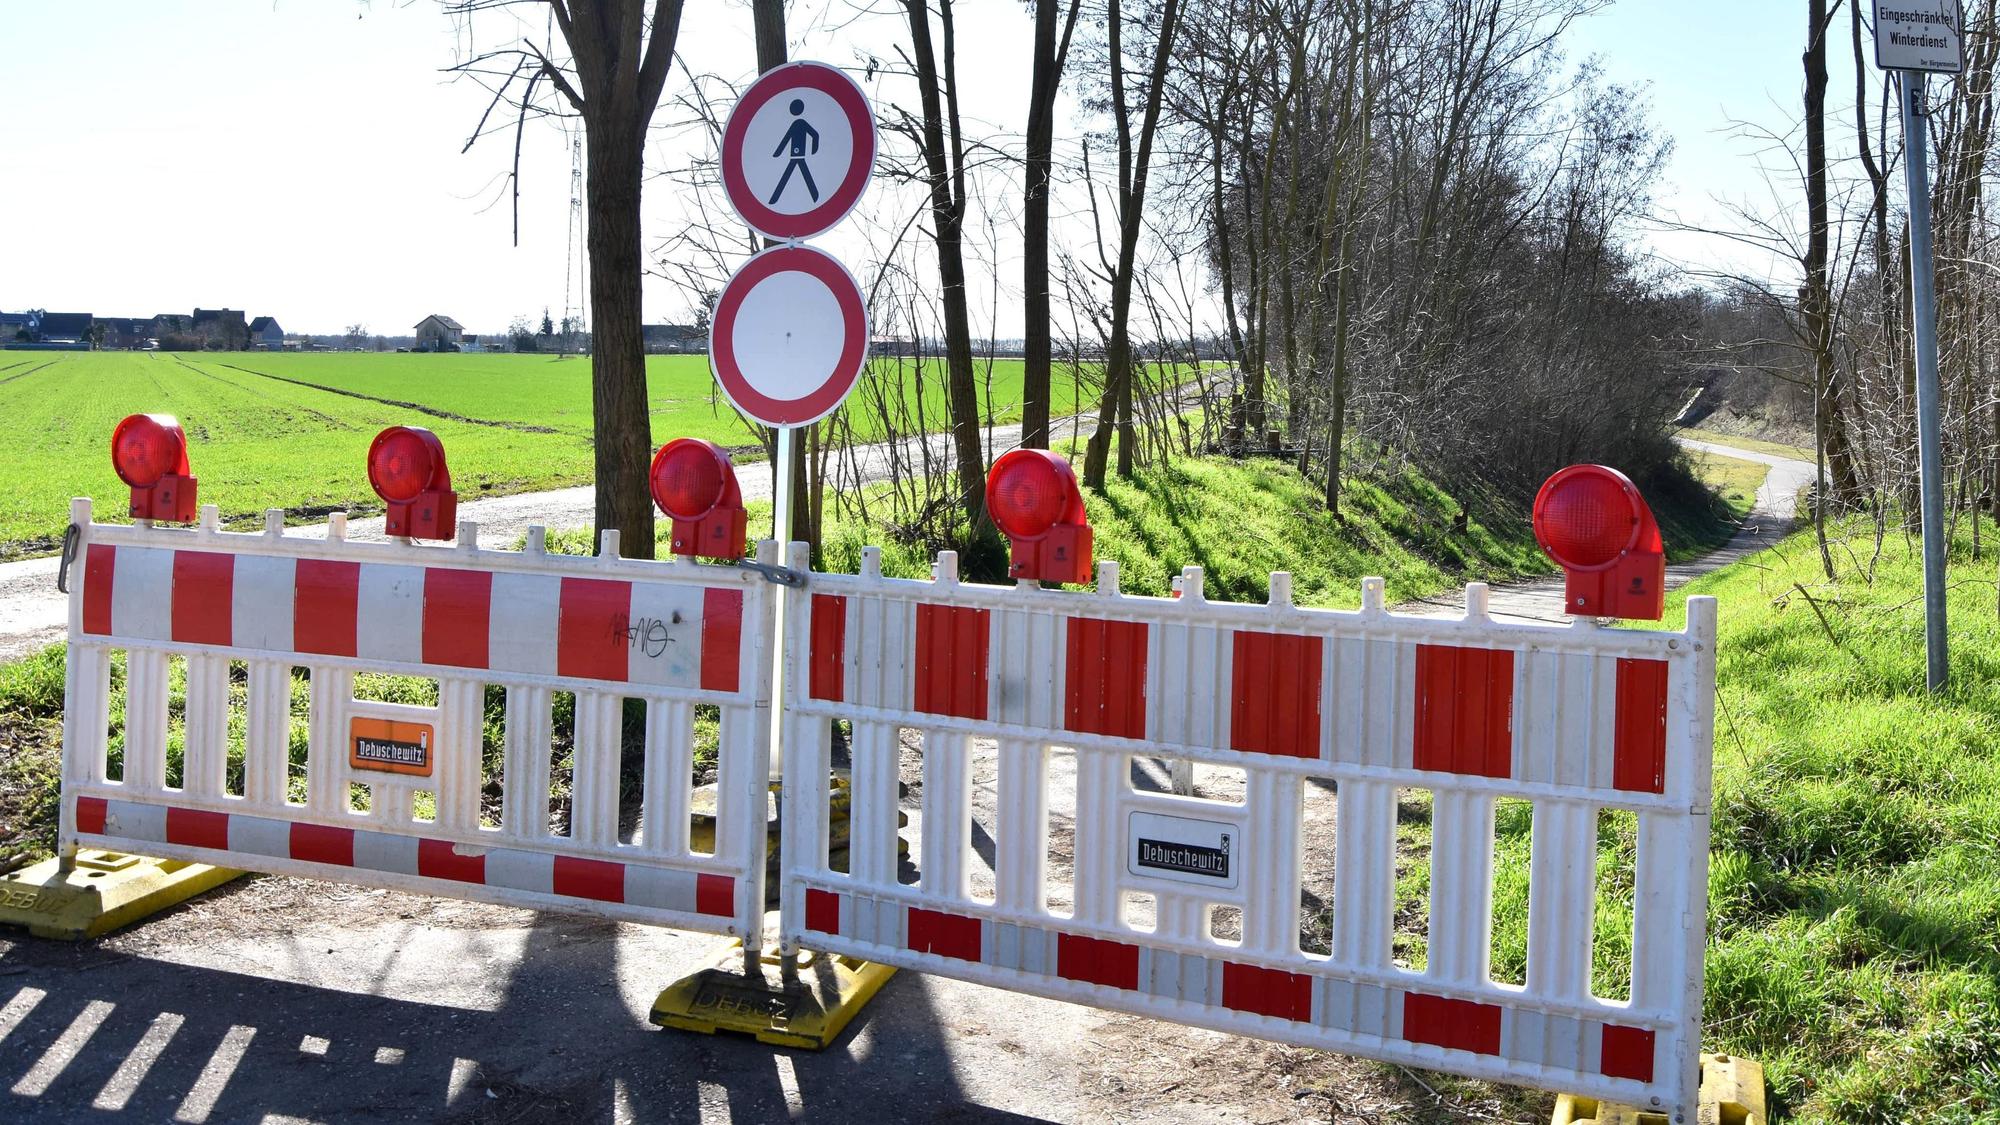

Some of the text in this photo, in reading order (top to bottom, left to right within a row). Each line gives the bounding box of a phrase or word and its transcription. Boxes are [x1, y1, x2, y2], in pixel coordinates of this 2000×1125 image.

[1880, 7, 1954, 25] Eingeschränkter
[1890, 32, 1948, 48] Winterdienst
[360, 741, 422, 762] Debuschewitz
[1143, 843, 1223, 871] Debuschewitz
